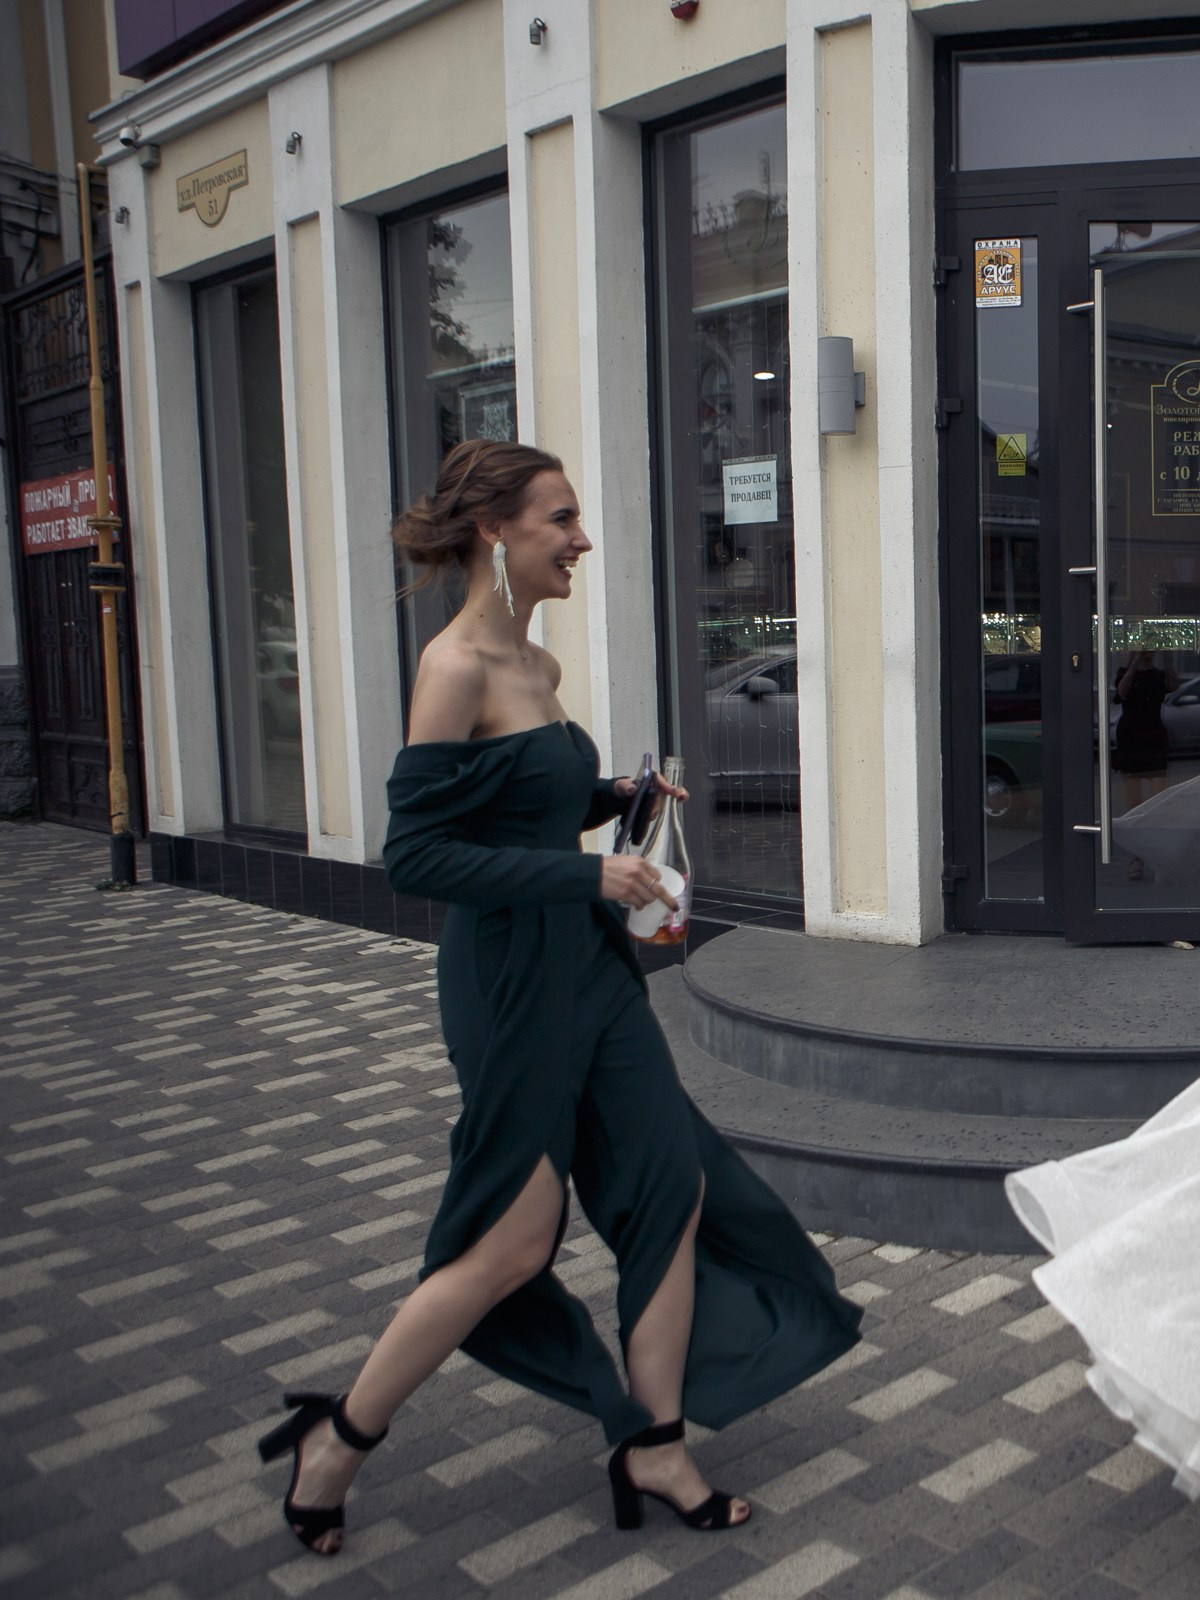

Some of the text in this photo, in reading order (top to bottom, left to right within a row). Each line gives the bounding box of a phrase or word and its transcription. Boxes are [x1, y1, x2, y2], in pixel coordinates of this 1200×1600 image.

[208, 199, 219, 216] 51
[977, 240, 1018, 248] ОХРАНА
[729, 472, 771, 486] ТРЕБУЕТСЯ
[1160, 471, 1167, 480] с
[1174, 466, 1190, 480] 10
[24, 480, 72, 513] ПОЖАРНЫЙ
[731, 490, 772, 503] ПРОДАВЕЦ
[26, 519, 65, 545] РАБОТАЕТ
